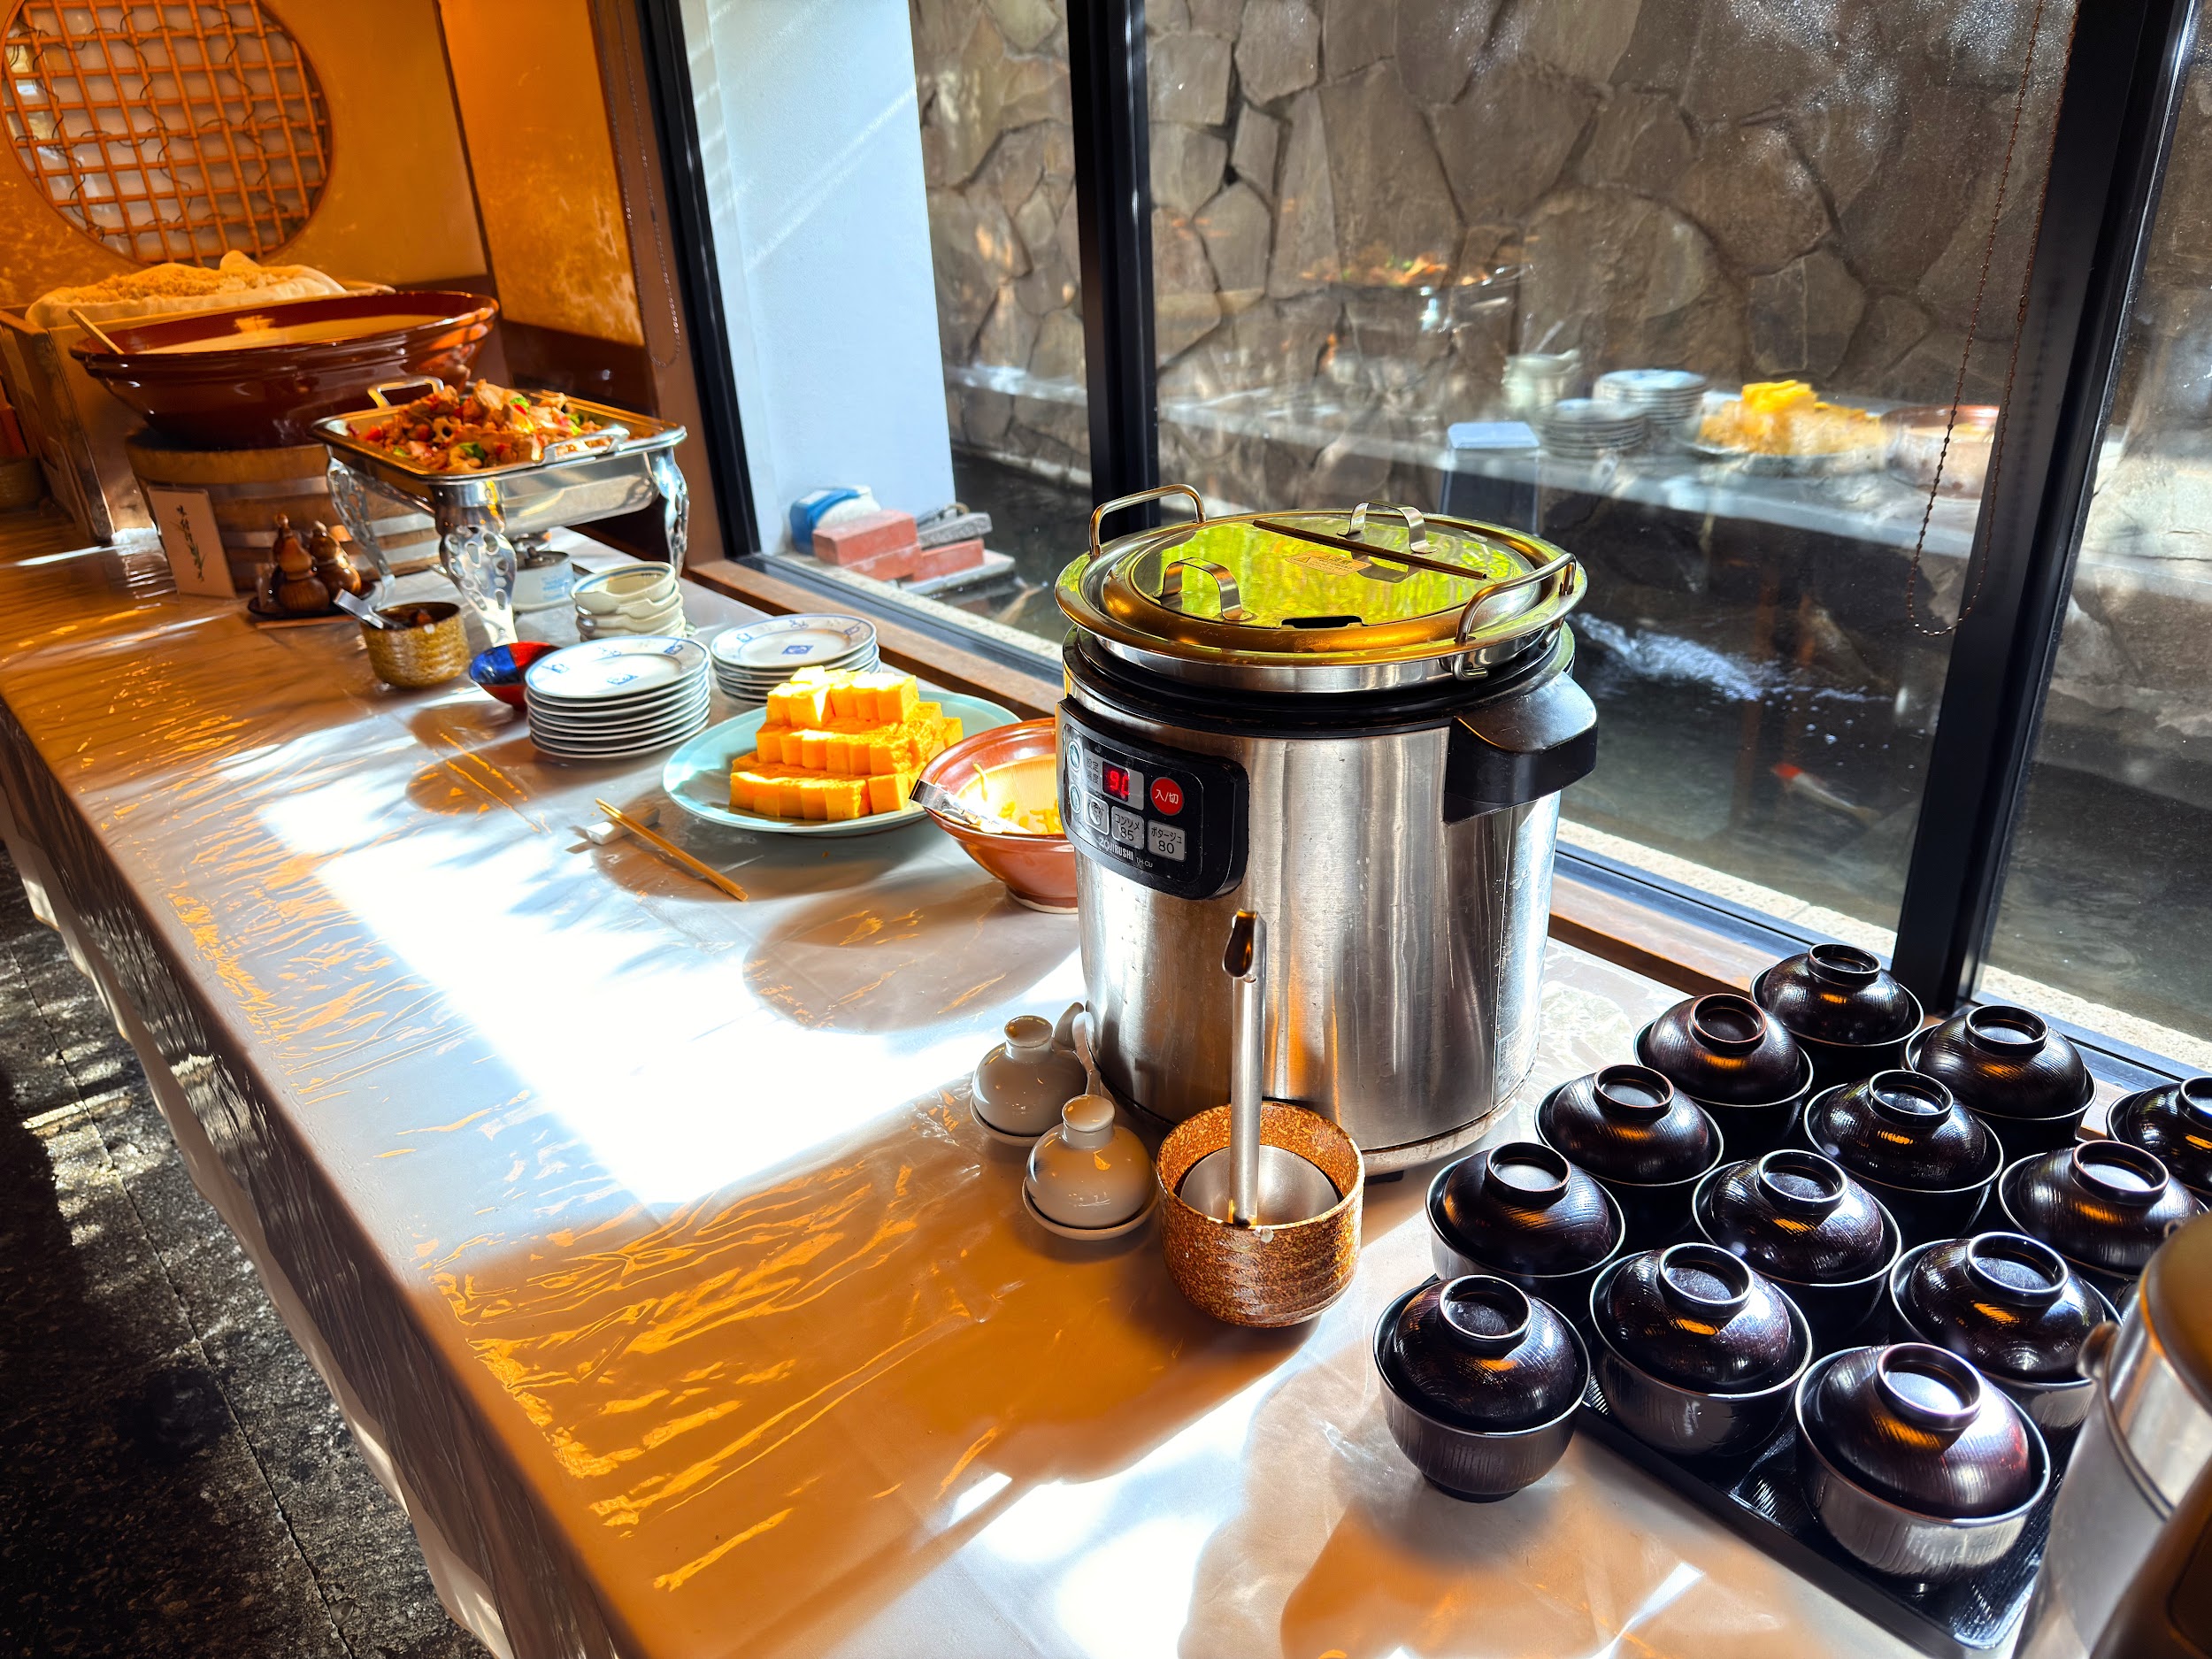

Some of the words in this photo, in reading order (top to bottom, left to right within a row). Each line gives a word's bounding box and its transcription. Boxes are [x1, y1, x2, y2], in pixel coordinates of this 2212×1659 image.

[1155, 788, 1179, 805] 入/切
[1115, 813, 1141, 831] コンソメ
[1120, 826, 1134, 841] 85
[1151, 826, 1183, 844] ポタージュ
[1098, 836, 1133, 860] ZOJIRUSHI
[1158, 840, 1175, 854] 80
